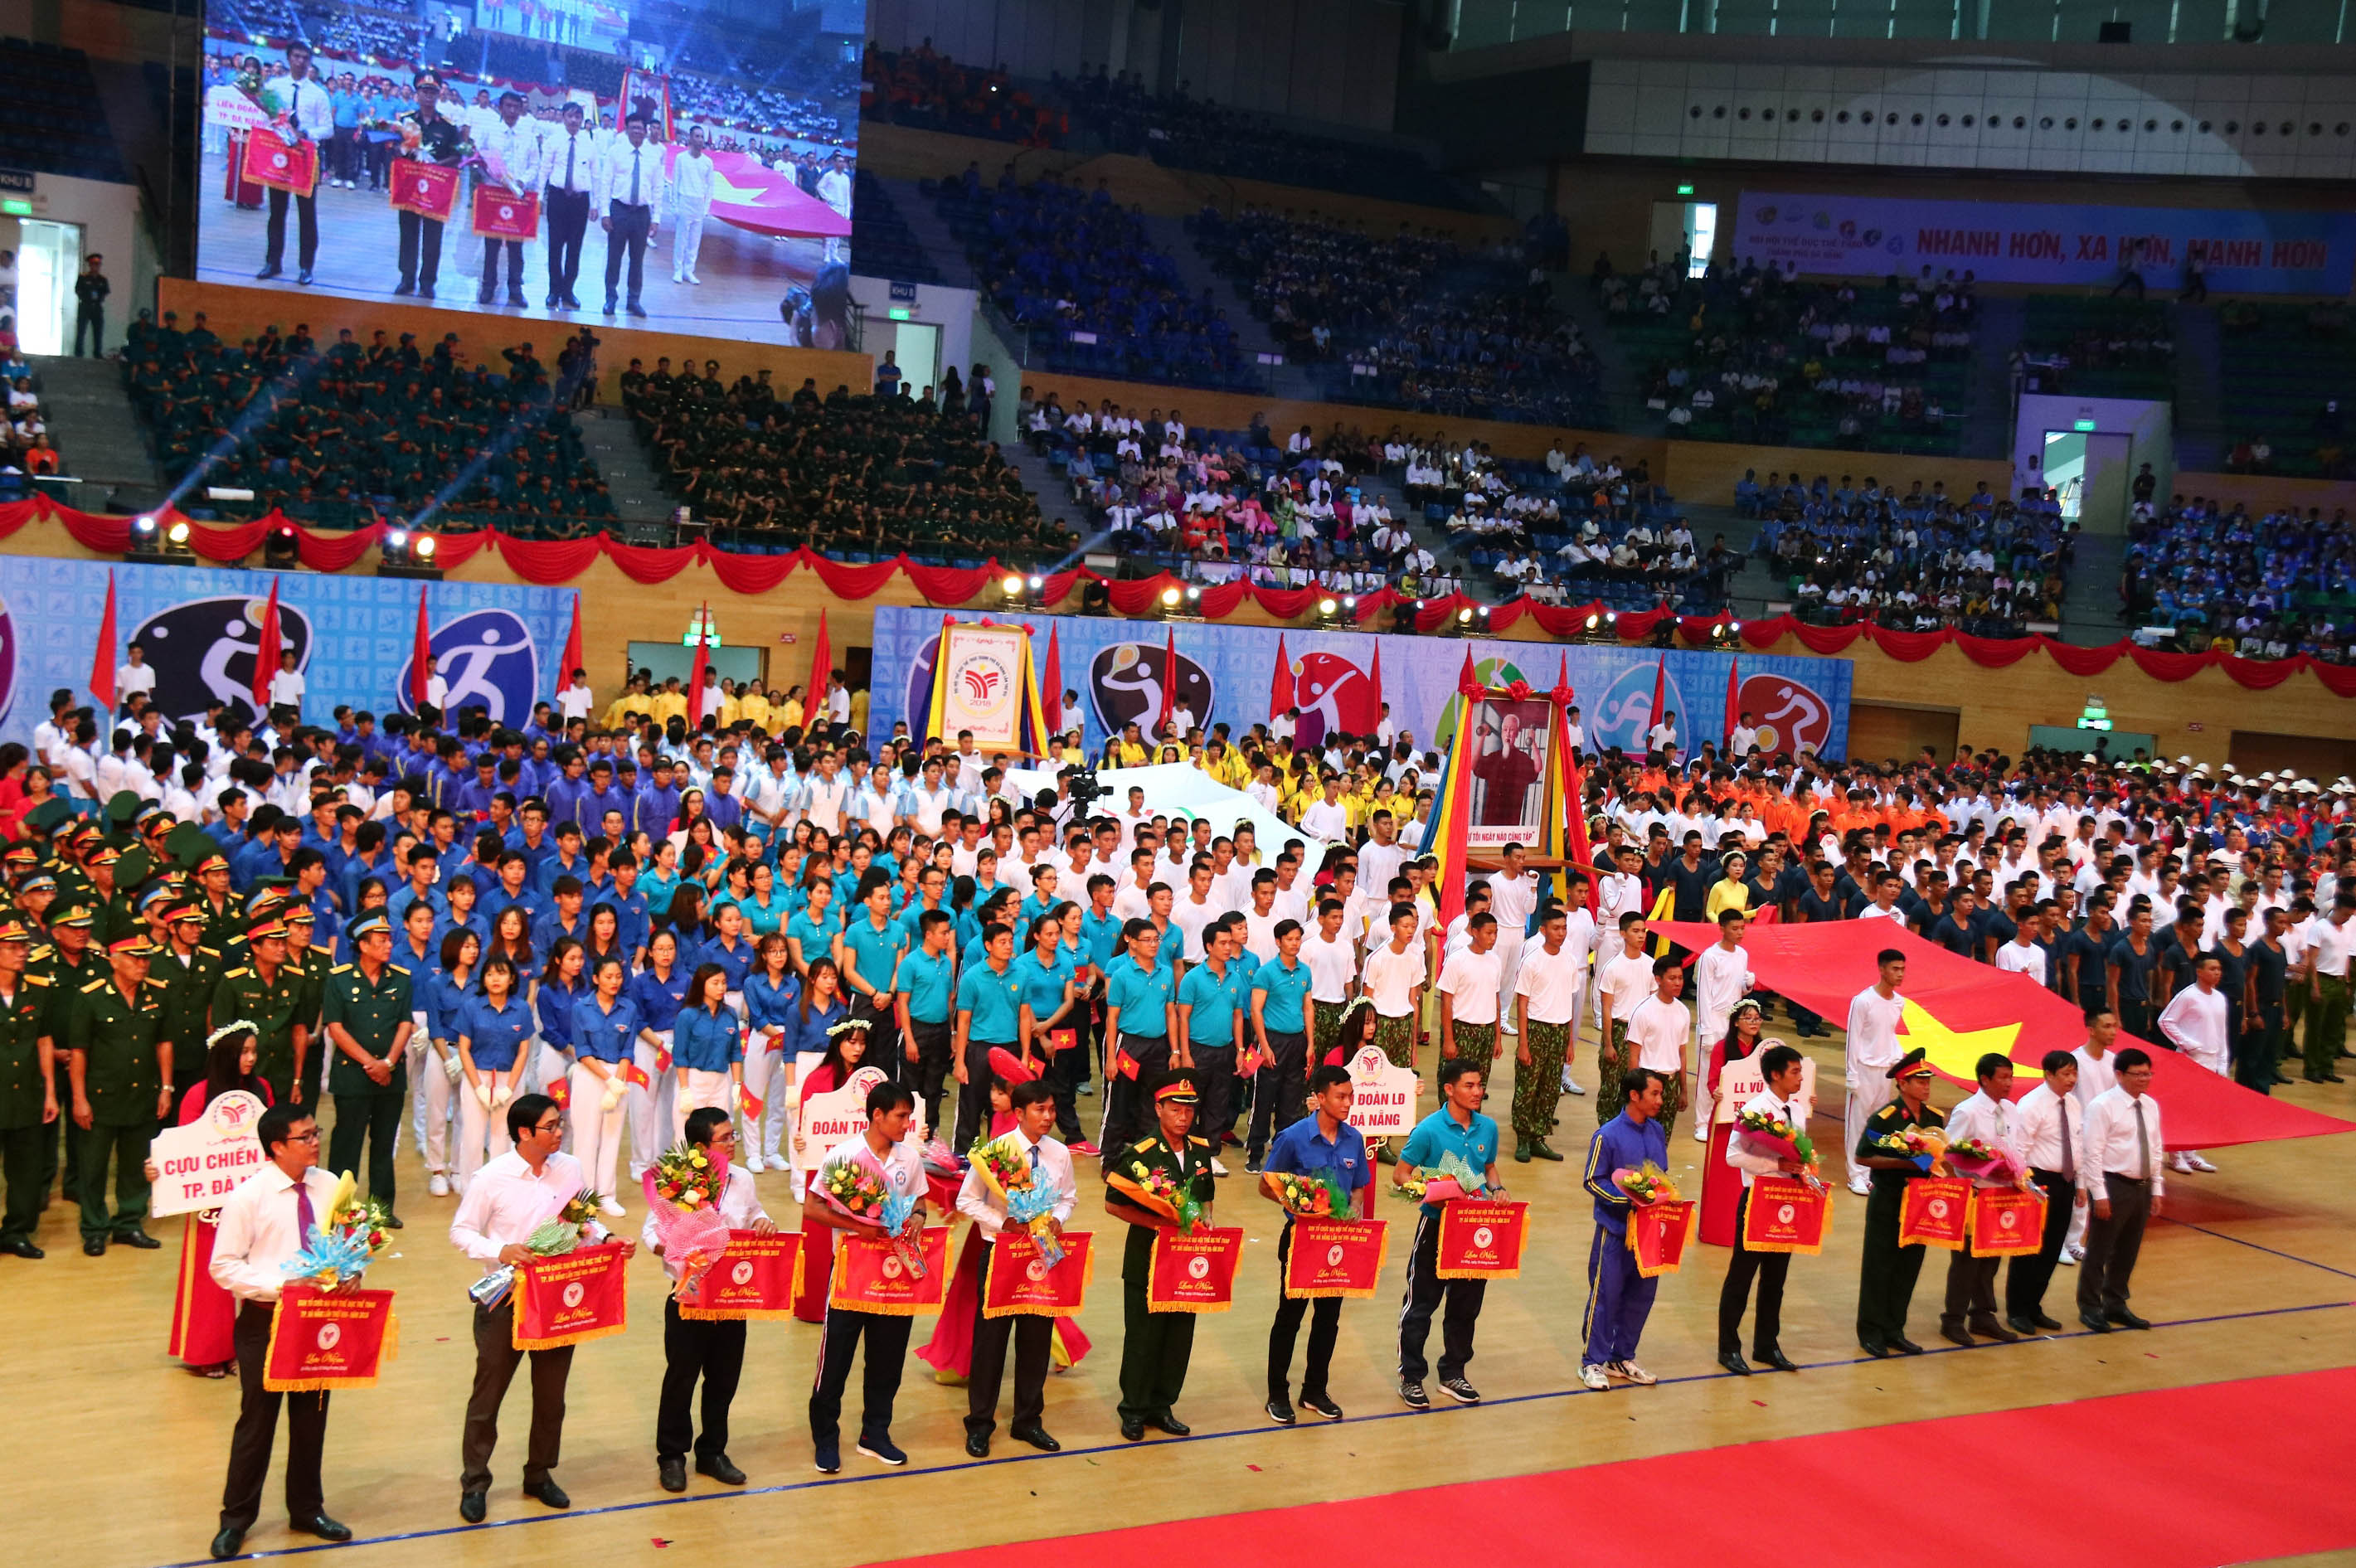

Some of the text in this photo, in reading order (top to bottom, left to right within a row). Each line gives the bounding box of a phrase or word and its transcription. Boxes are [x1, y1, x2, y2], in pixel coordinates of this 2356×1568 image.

[1917, 228, 2000, 257] NHANH
[2009, 229, 2067, 265] HƠN,
[2076, 234, 2108, 262] XA
[2271, 235, 2328, 269] HƠN
[970, 699, 991, 707] 2018
[1482, 831, 1495, 841] NGÀY
[1496, 831, 1506, 841] NÀO
[1508, 831, 1521, 841] CŨNG
[1734, 1080, 1763, 1093] LL VŨ
[1358, 1091, 1389, 1105] ĐOÀN
[1392, 1093, 1405, 1105] LĐ
[1350, 1110, 1400, 1126] ĐÀ NẴNG
[812, 1118, 848, 1135] ĐOÀN
[165, 1145, 258, 1177] CỰU CHIẾN
[183, 1183, 206, 1199] TP.
[212, 1175, 234, 1195] ĐÀ
